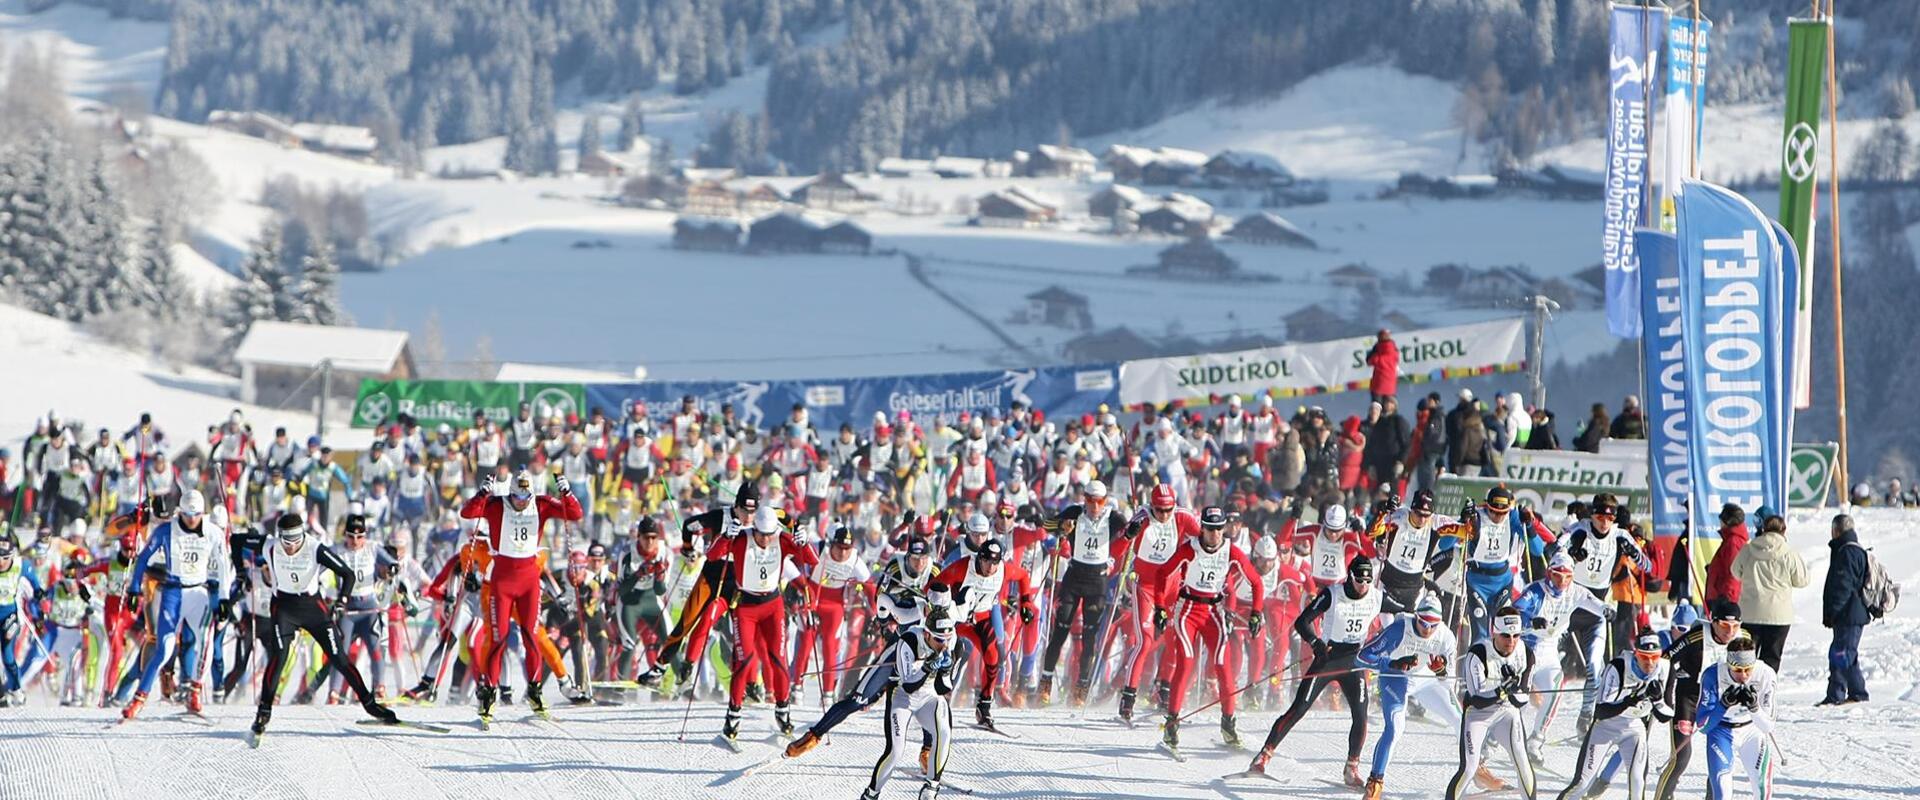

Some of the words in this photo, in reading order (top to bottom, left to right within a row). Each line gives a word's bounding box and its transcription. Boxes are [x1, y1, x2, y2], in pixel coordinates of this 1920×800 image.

[513, 526, 529, 542] 18
[1083, 536, 1099, 550] 44
[1152, 537, 1167, 552] 45
[1487, 538, 1500, 550] 13
[182, 551, 198, 564] 20
[1400, 545, 1416, 560] 14
[1322, 553, 1337, 568] 23
[1587, 557, 1603, 572] 31
[290, 572, 299, 583] 9
[759, 565, 768, 580] 8
[1200, 570, 1215, 583] 16
[1345, 618, 1362, 633] 35
[1669, 642, 1686, 658] Audi
